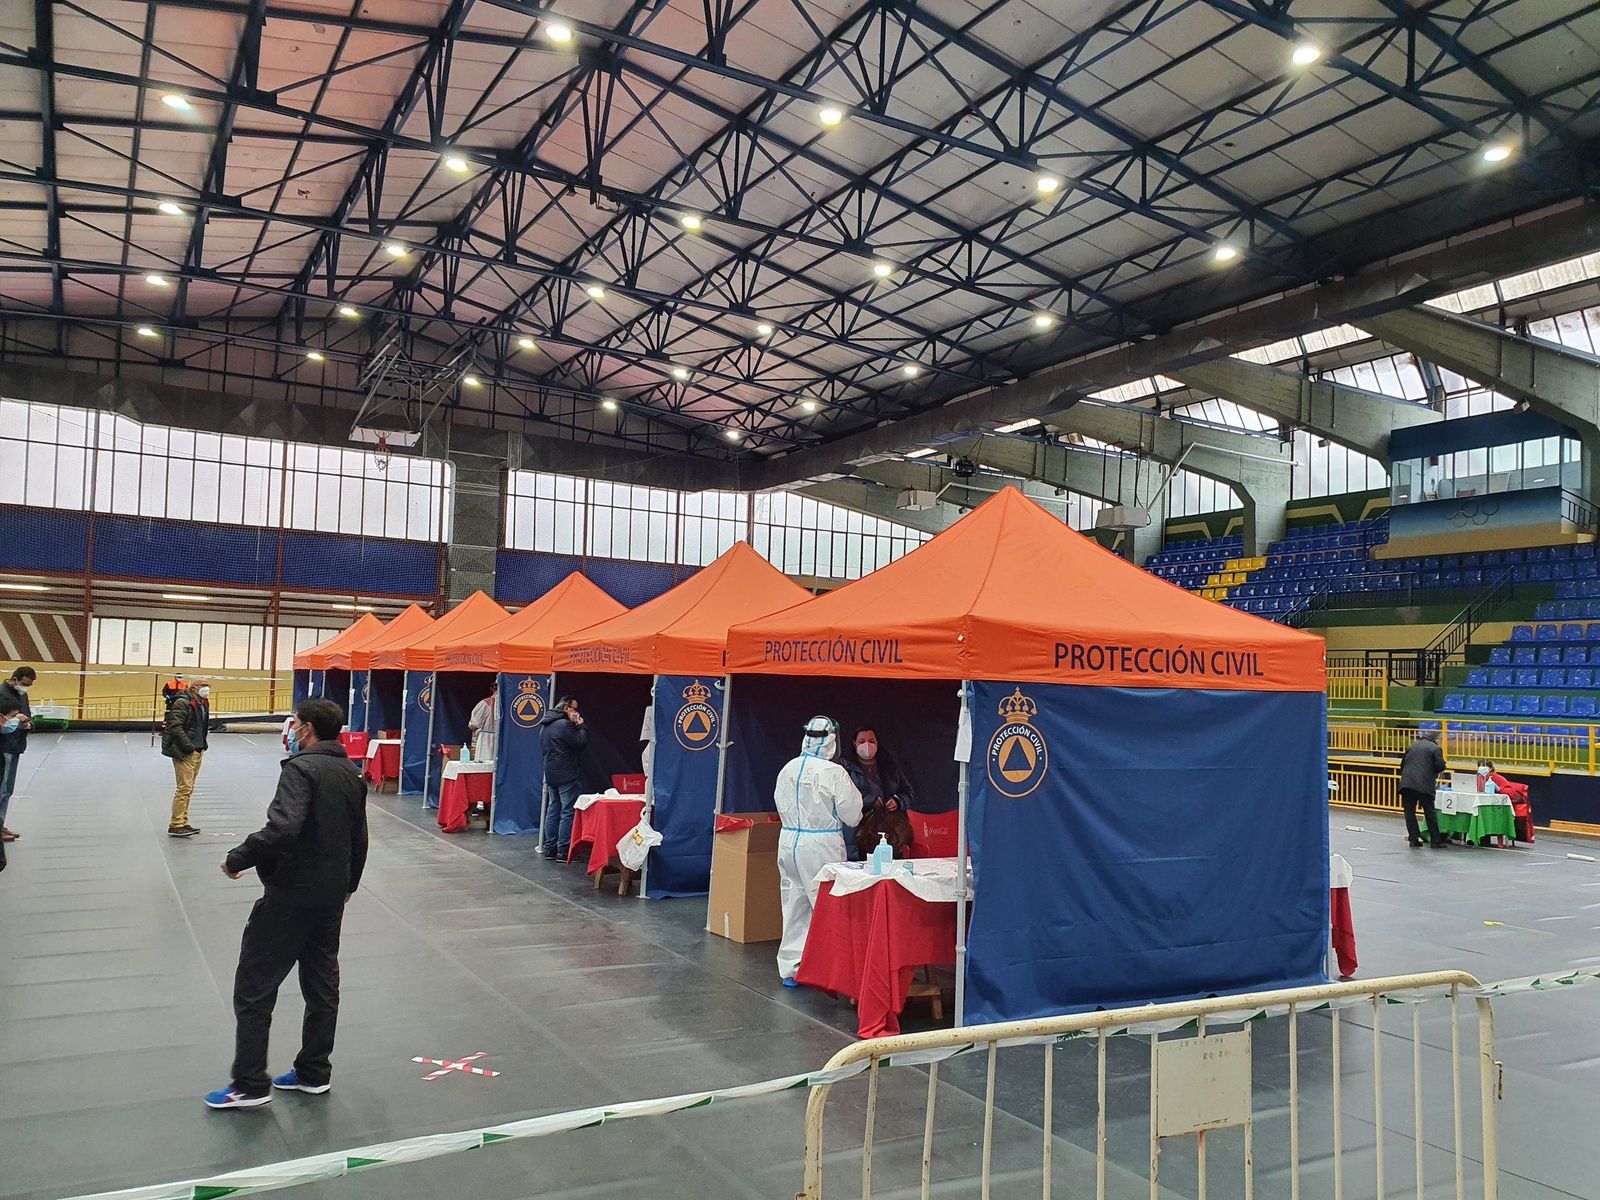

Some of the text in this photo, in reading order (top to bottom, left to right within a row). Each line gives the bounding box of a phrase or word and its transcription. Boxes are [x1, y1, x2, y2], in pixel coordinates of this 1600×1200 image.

[764, 634, 904, 664] PROTECCIÓN CIVIL
[1054, 642, 1264, 677] PROTECCIÓN CIVIL
[678, 704, 716, 724] PROTECCIÓN CIVIL
[991, 725, 1044, 756] PROTECCIÓN CIVIL
[1446, 798, 1453, 809] 2
